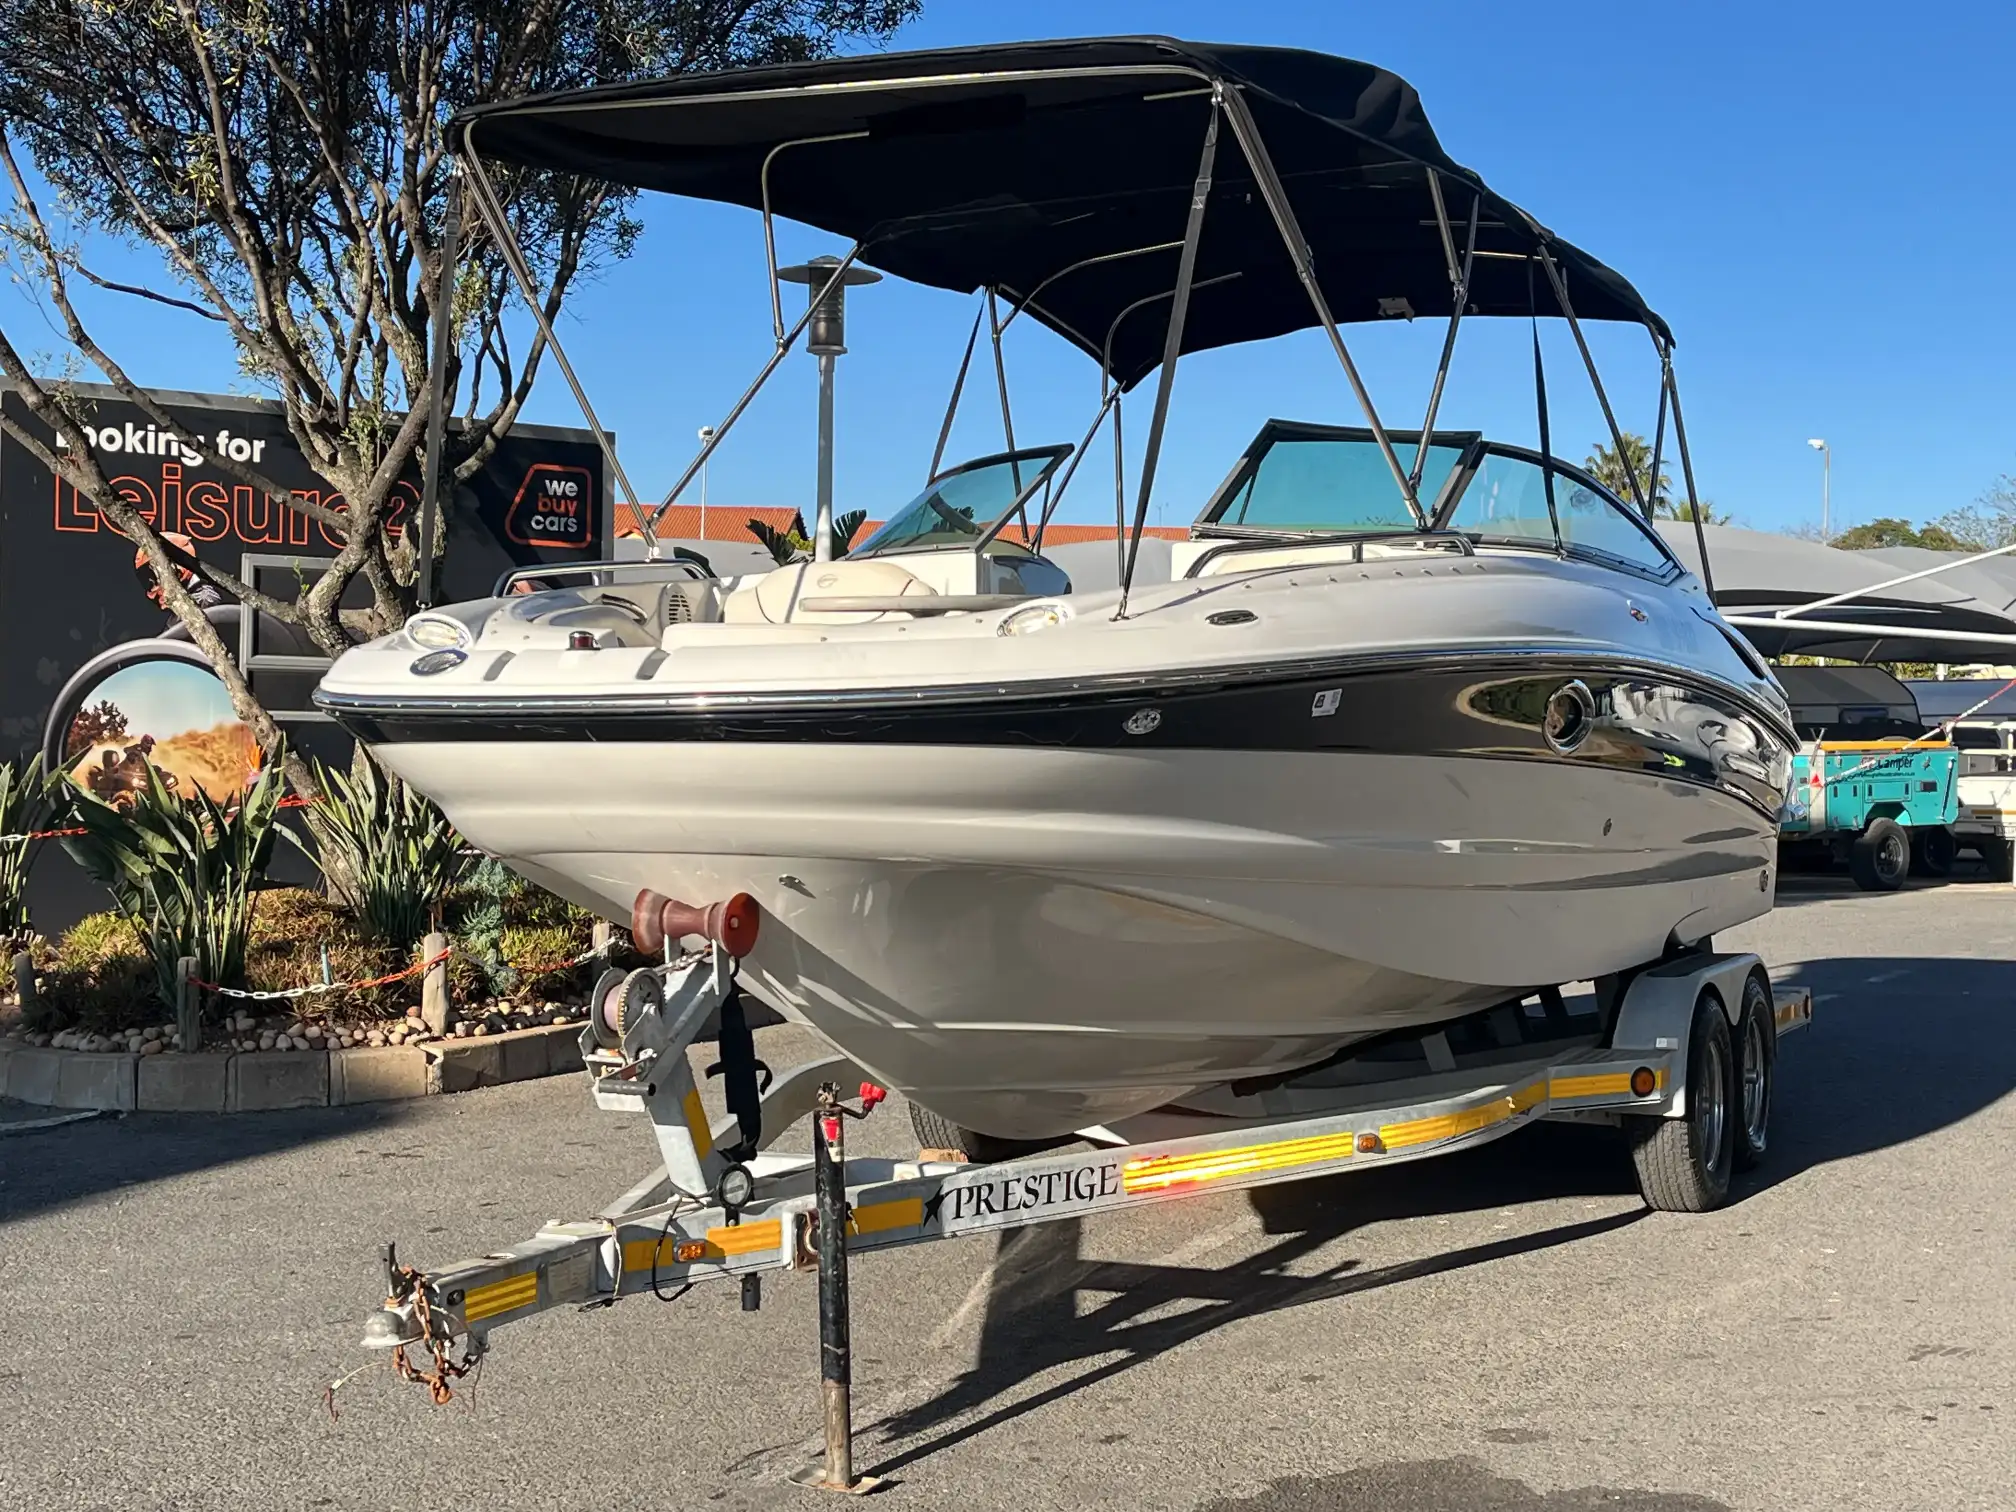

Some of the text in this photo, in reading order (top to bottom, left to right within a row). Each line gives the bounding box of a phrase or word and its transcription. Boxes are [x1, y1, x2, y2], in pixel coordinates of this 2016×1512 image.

[216, 429, 266, 463] for
[545, 479, 578, 497] we
[537, 492, 578, 517] buy
[530, 514, 578, 533] cars
[943, 1163, 1119, 1221] PRESTIGE
